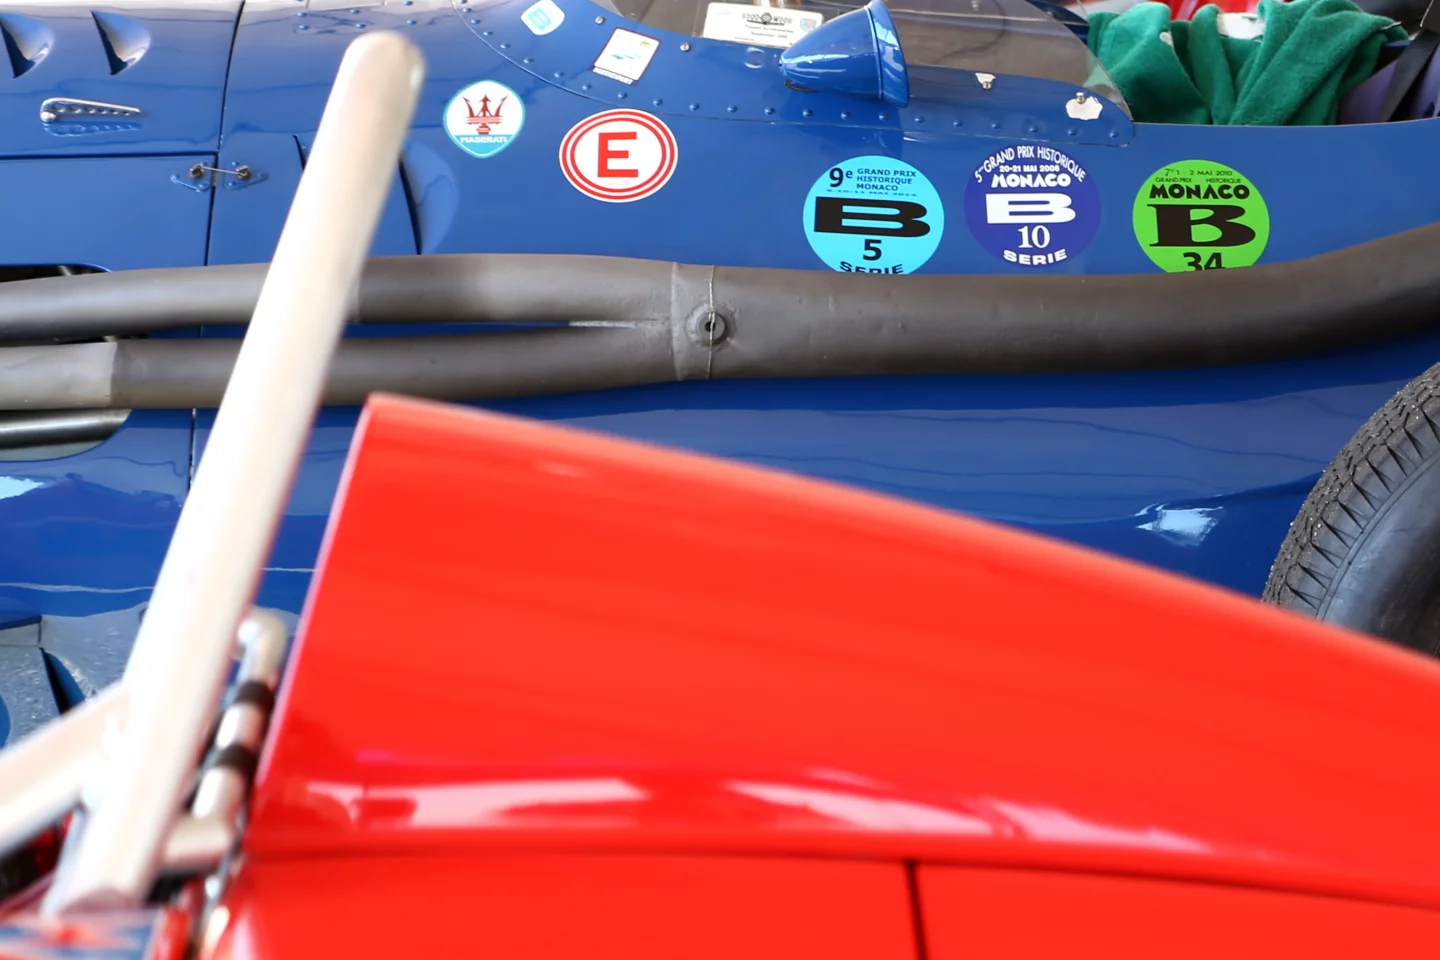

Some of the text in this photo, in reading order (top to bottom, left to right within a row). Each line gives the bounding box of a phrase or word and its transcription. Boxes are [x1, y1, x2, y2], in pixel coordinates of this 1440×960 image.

[597, 131, 639, 178] E
[983, 147, 1015, 173] GRAND
[1017, 145, 1035, 159] PRIX
[1037, 146, 1087, 183] HISTORIQUE
[829, 167, 916, 188] 9e GRAND PRIX
[999, 164, 1021, 172] 20-21
[857, 176, 912, 185] HISTORIQUE
[991, 173, 1071, 188] MONACO
[1149, 184, 1250, 200] MONACO
[814, 196, 931, 238] B
[985, 192, 1076, 224] B
[1147, 204, 1256, 247] B
[1017, 225, 1050, 248] 10
[863, 239, 882, 261] 5
[1003, 248, 1067, 265] SERIE
[1183, 252, 1226, 270] 34
